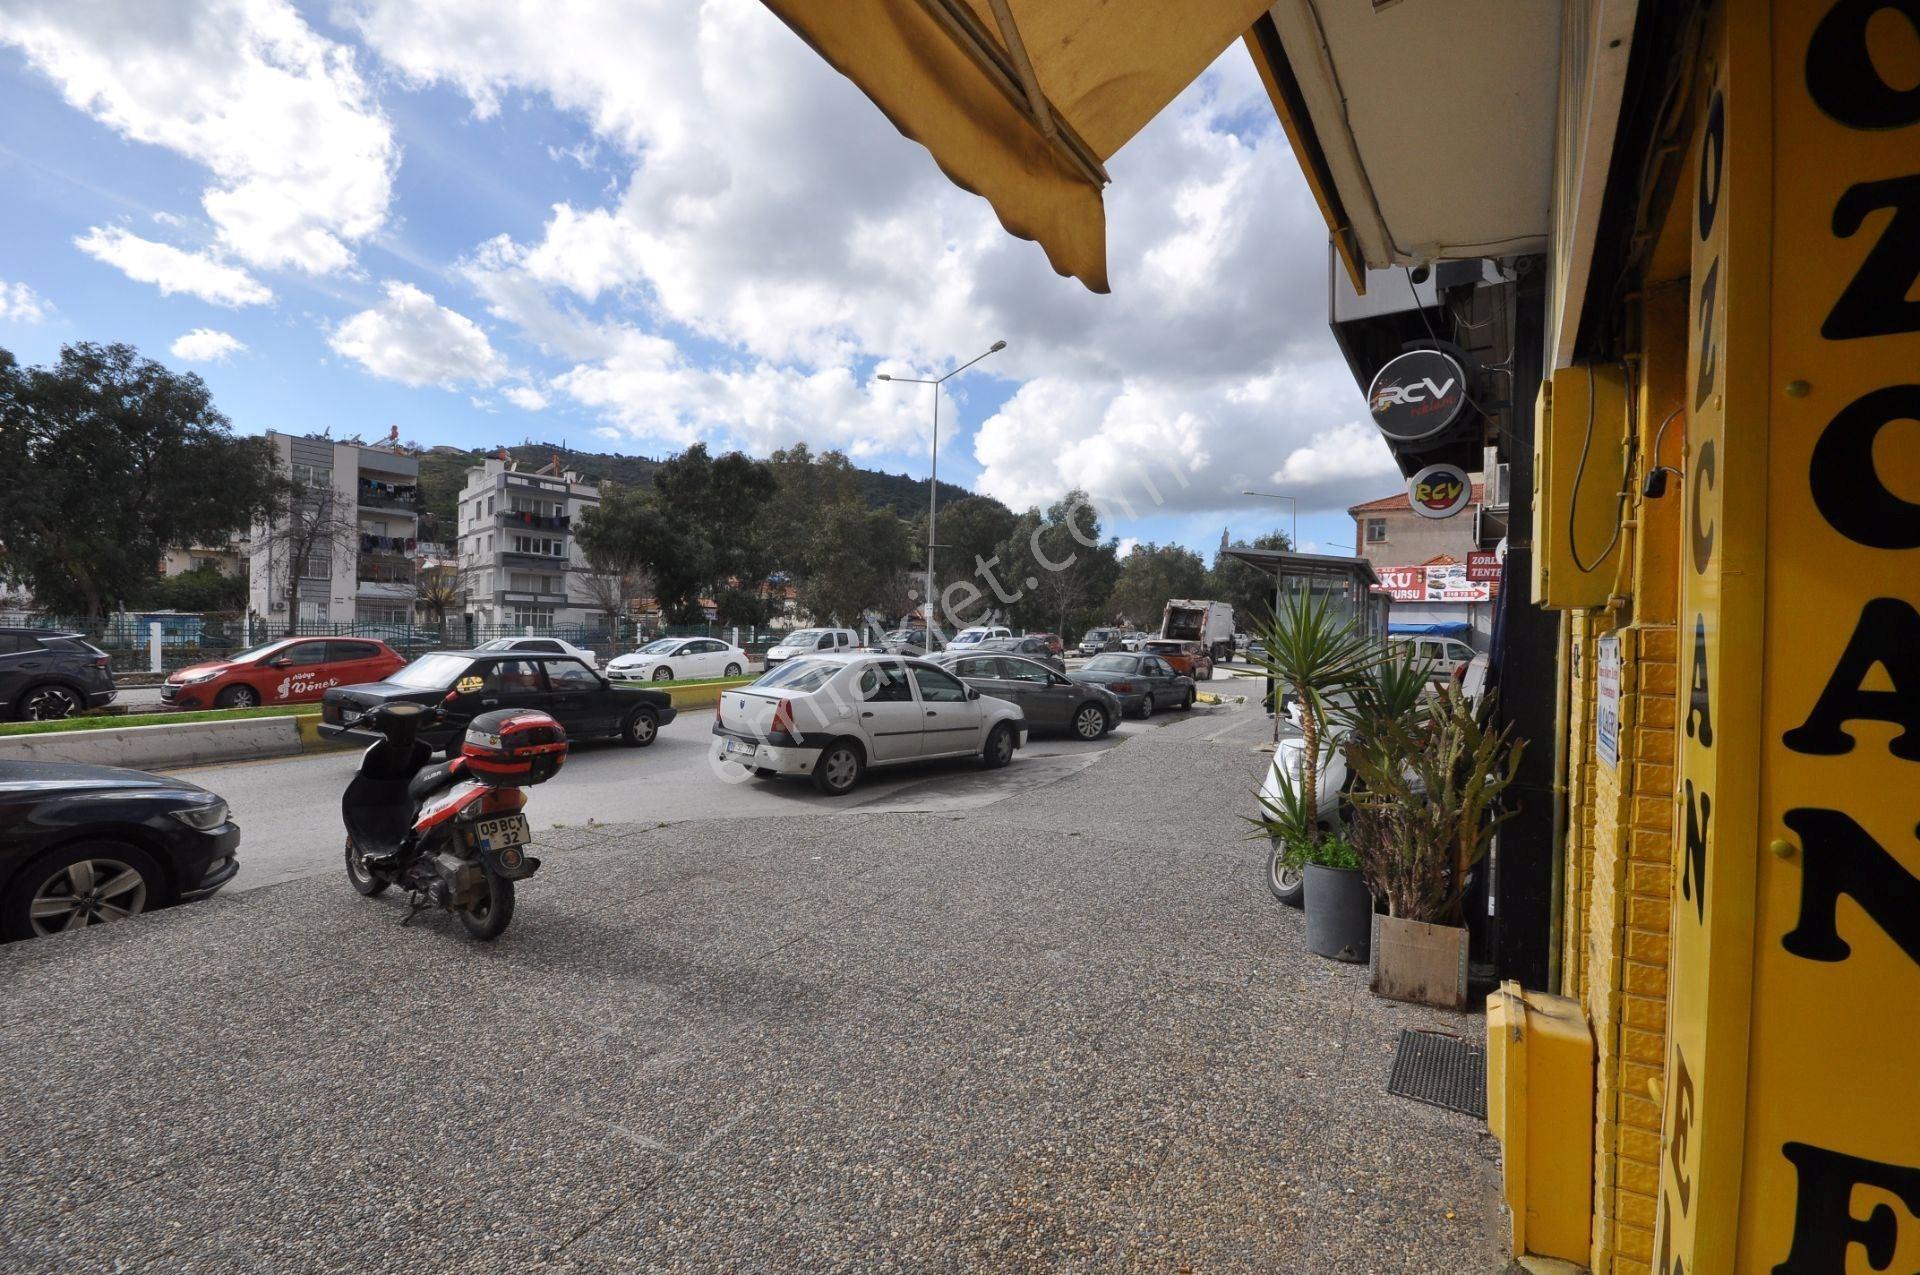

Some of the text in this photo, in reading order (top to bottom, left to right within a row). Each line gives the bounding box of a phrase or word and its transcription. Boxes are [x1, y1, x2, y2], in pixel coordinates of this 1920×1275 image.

[1377, 377, 1455, 407] RCV
[1415, 481, 1464, 502] RCV
[1471, 556, 1502, 565] ZORL
[481, 821, 498, 835] 09
[502, 831, 520, 845] 32
